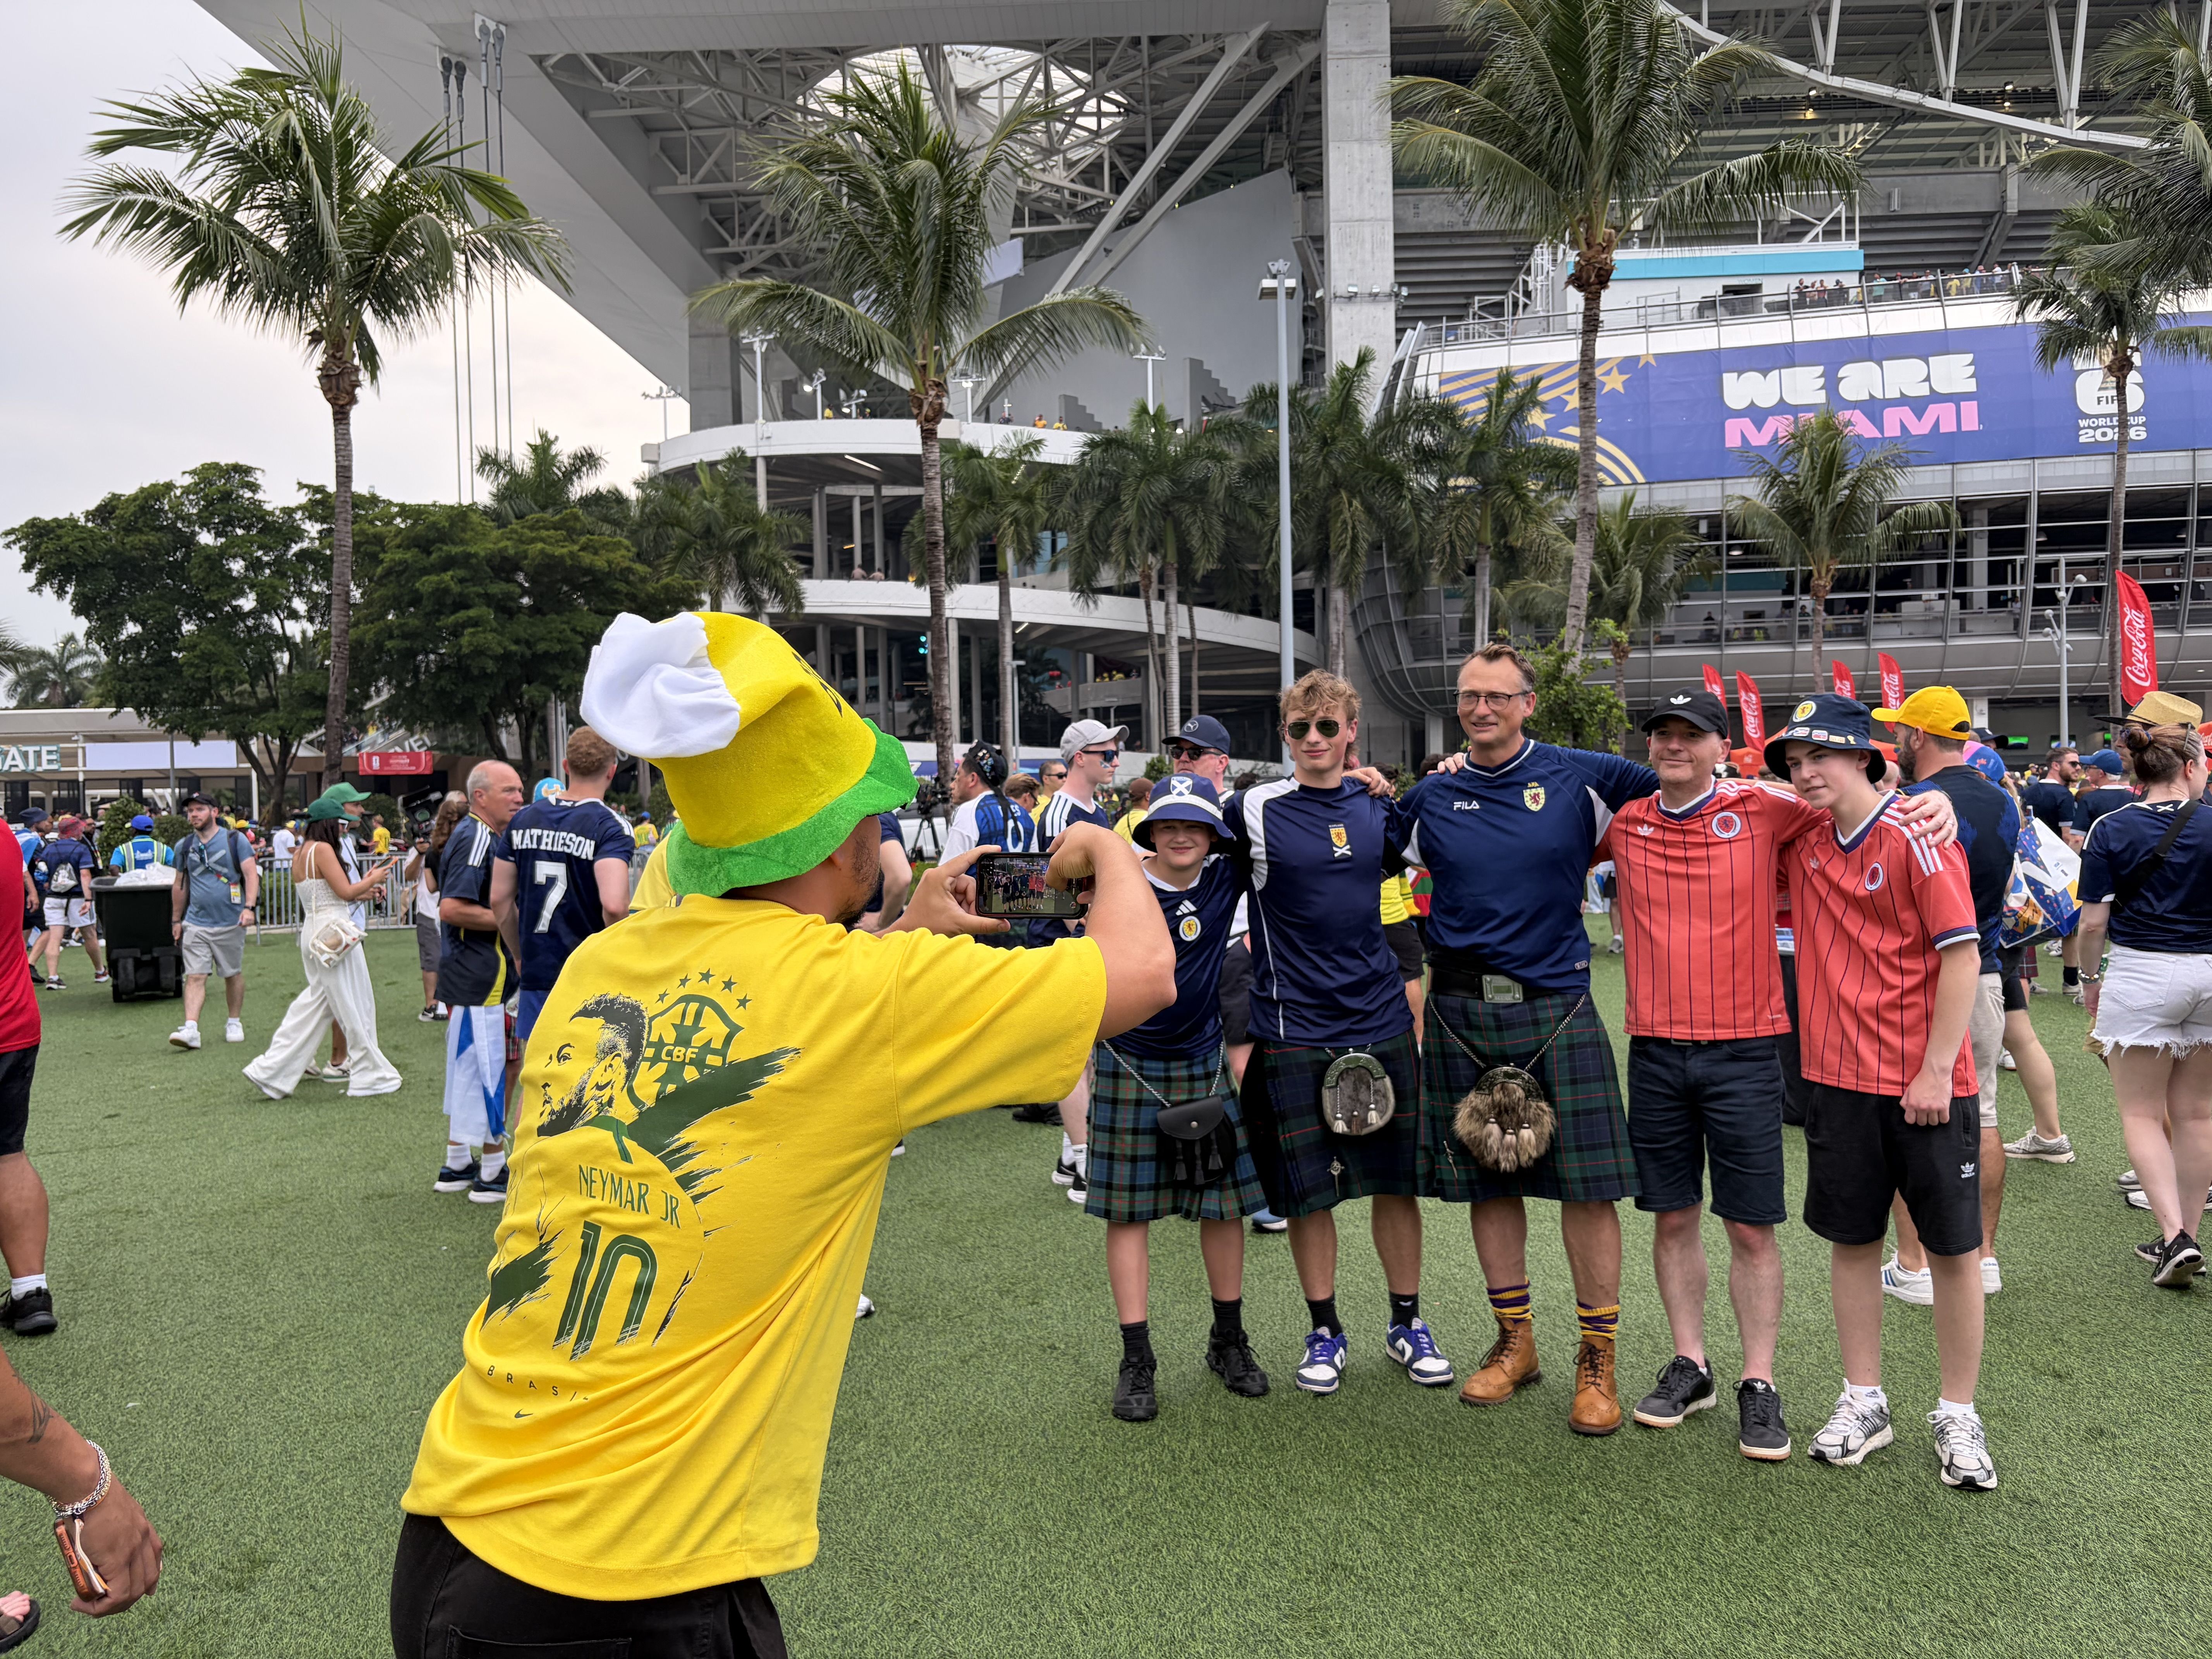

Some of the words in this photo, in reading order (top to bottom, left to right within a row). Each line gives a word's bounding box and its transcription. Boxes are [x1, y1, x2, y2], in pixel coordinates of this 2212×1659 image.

[1723, 366, 1826, 409] WE
[2097, 395, 2118, 405] FIF
[1725, 401, 1979, 448] MAMI
[0, 746, 60, 771] ATE
[1453, 800, 1480, 811] FILA
[511, 828, 596, 861] MATHIESON
[533, 860, 568, 933] 7
[661, 1046, 699, 1063] CBF
[579, 1164, 650, 1215] NEYMAR
[660, 1190, 681, 1229] JR
[552, 1220, 658, 1362] 10
